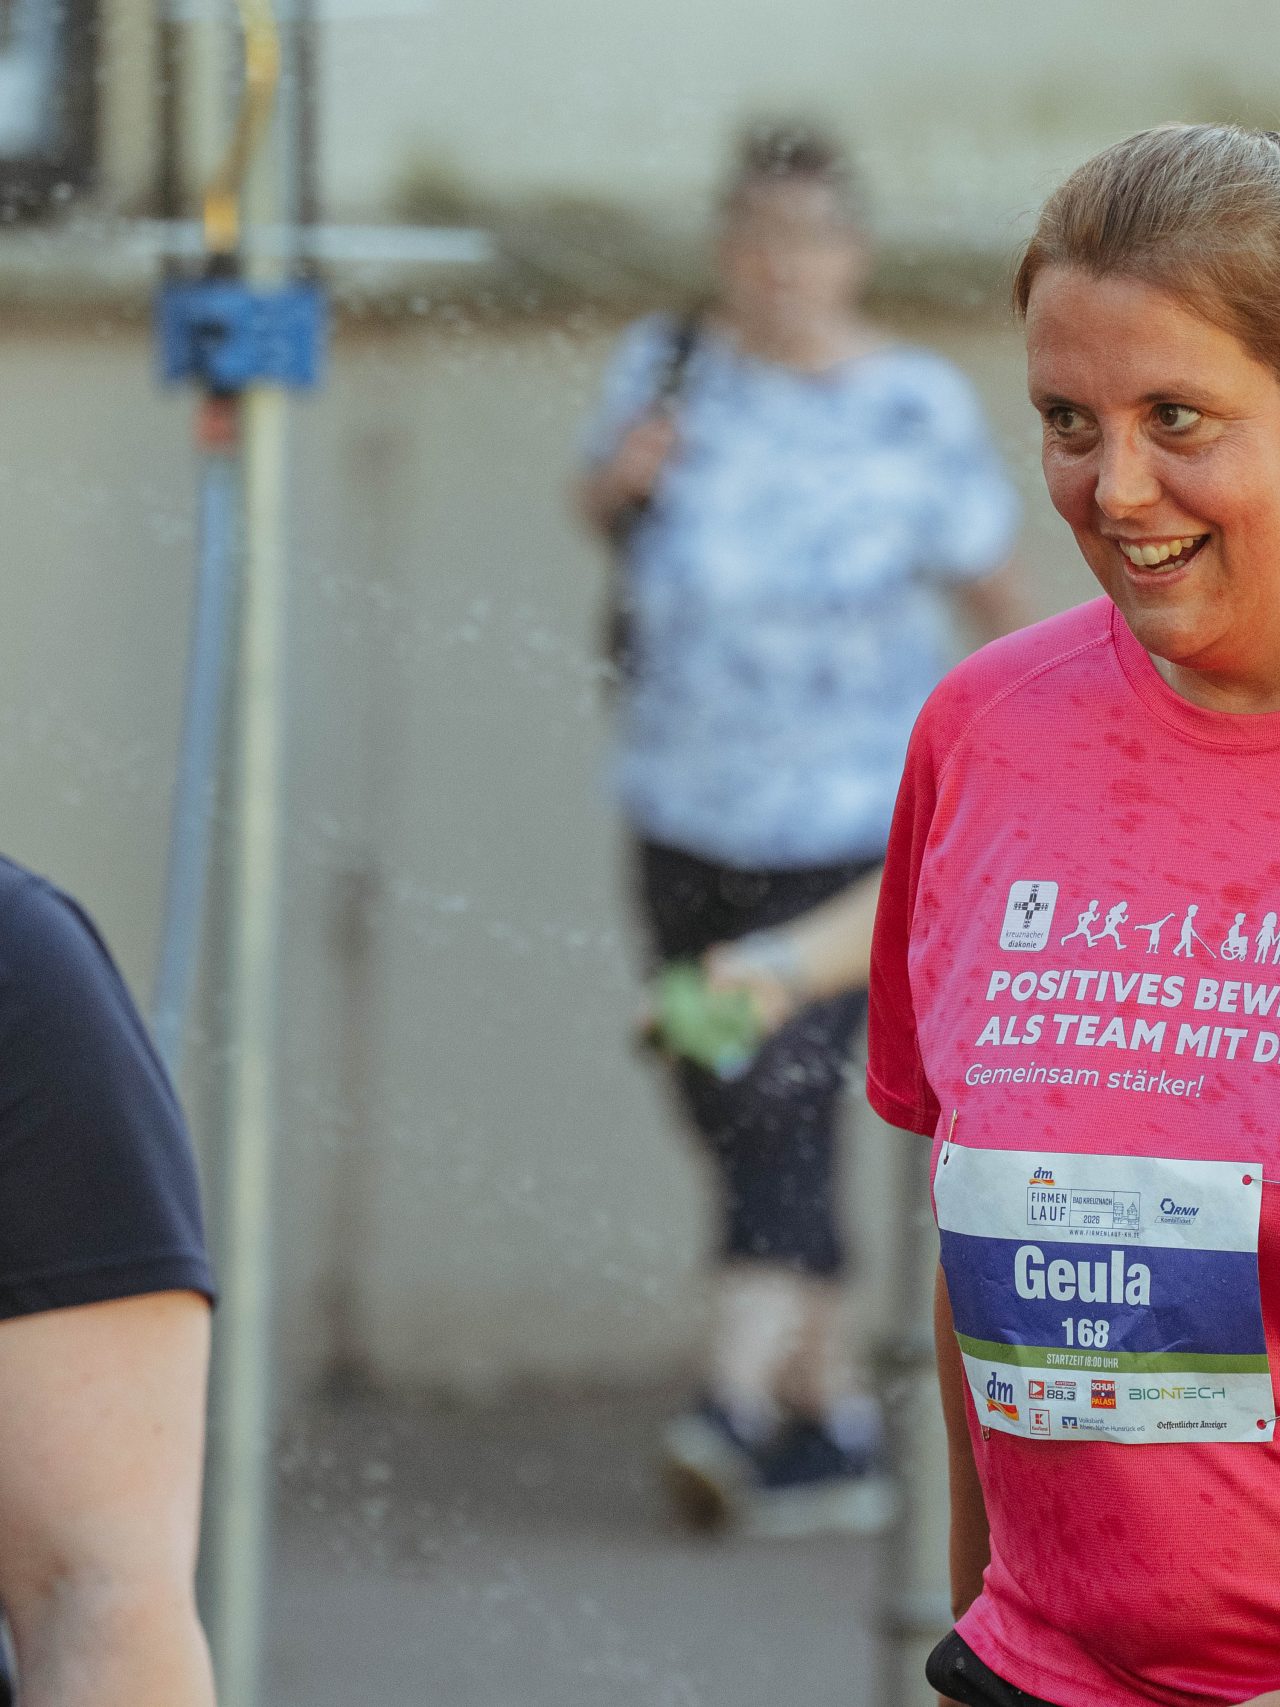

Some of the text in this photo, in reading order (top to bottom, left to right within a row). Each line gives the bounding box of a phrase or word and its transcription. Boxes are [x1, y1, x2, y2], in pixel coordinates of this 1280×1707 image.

[1006, 930, 1043, 939] kreuznacher
[1008, 941, 1037, 949] diakonie
[986, 969, 1185, 1008] POSITIVES
[975, 1014, 1045, 1047] ALS
[1053, 1013, 1167, 1053] TEAM
[1174, 1023, 1248, 1060] MIT
[965, 1061, 1205, 1098] Gemeinsam stärker!
[1033, 1167, 1053, 1180] dm
[1031, 1192, 1067, 1204] FIRMEN
[1072, 1196, 1113, 1206] BAD KREUZNACH
[1031, 1205, 1067, 1222] LAUF
[1173, 1206, 1200, 1217] RNN
[1014, 1244, 1151, 1306] Geula
[1061, 1317, 1110, 1349] 168
[1046, 1353, 1083, 1366] STARTZEIT
[1103, 1356, 1119, 1369] UHR
[986, 1371, 1014, 1404] dm
[1091, 1382, 1115, 1391] SCHUH
[1046, 1389, 1076, 1401] 88.3
[1128, 1387, 1226, 1401] BIONTECH
[1091, 1397, 1116, 1406] PALAST
[1199, 1420, 1227, 1430] Anzeiger
